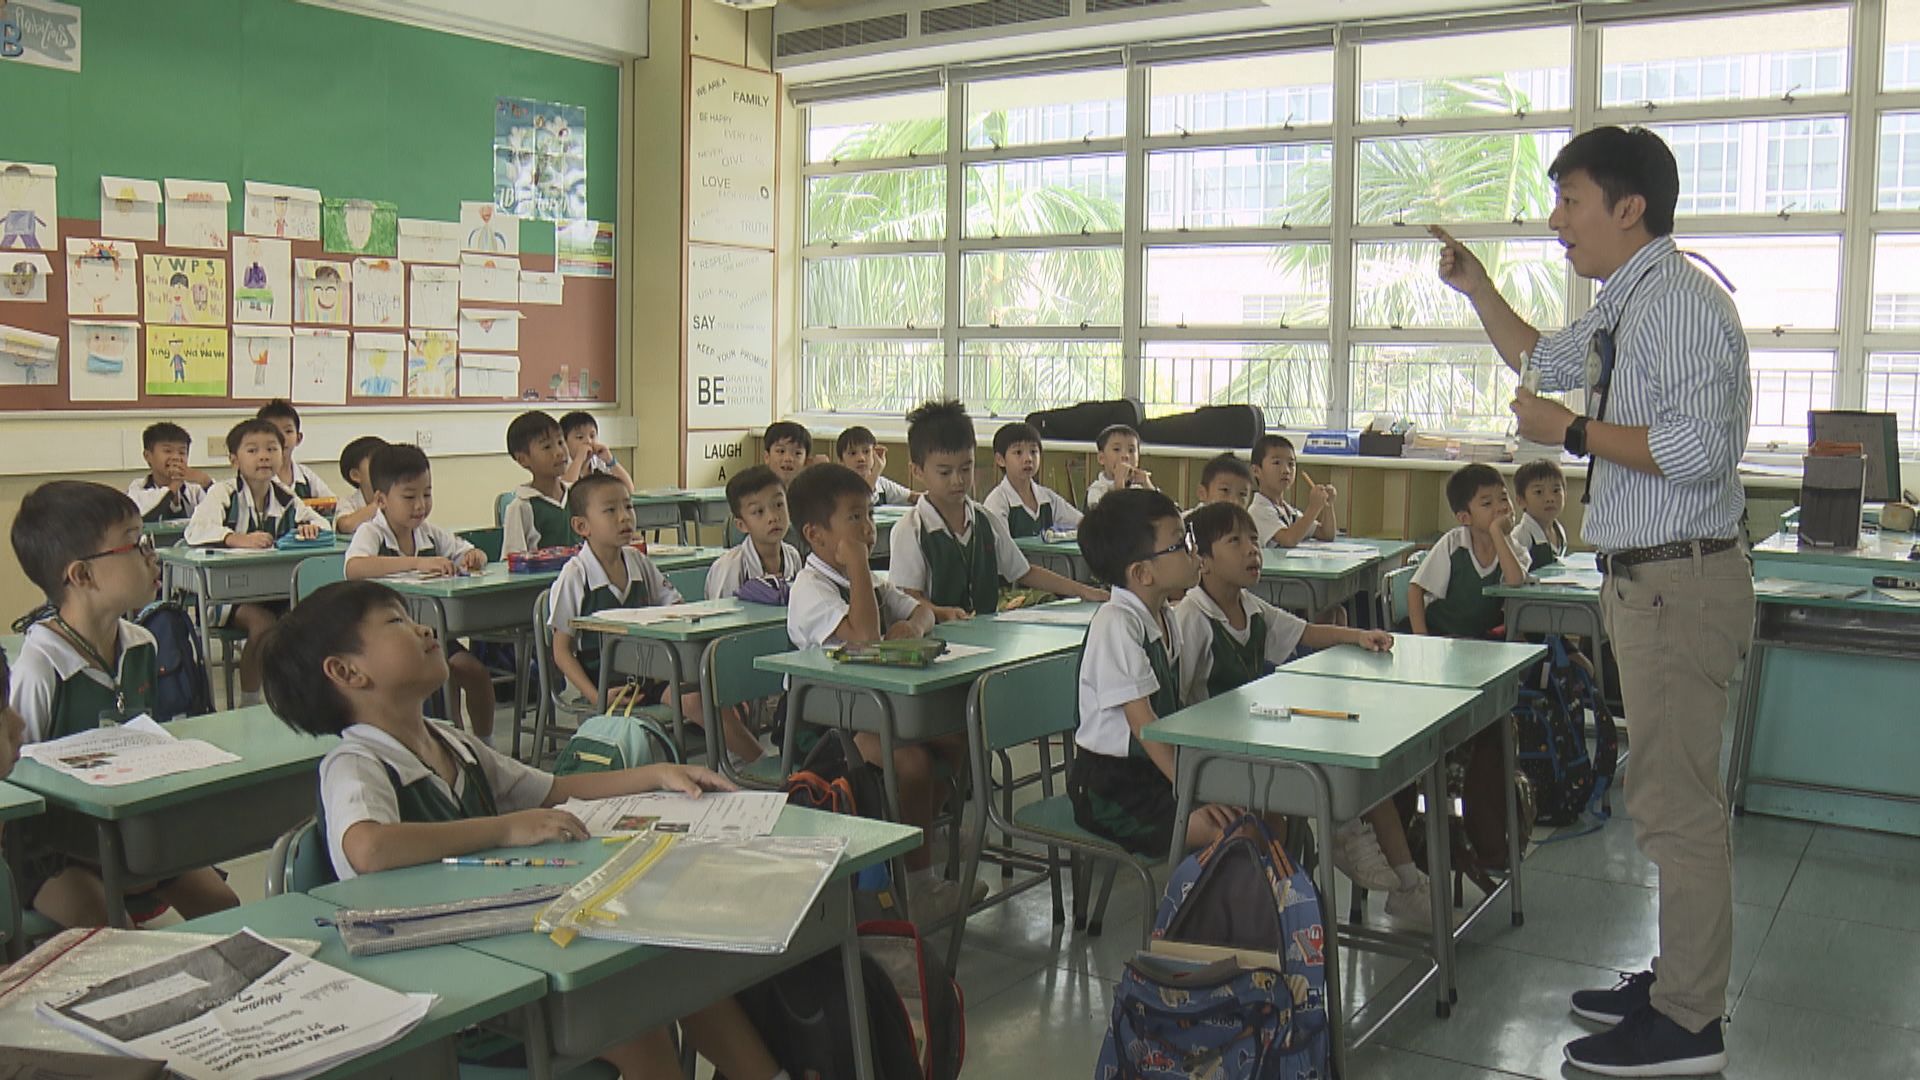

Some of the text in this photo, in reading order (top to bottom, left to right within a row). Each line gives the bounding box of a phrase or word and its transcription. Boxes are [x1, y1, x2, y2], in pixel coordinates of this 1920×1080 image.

[733, 91, 769, 107] FAMILY
[702, 175, 731, 189] LOVE
[693, 315, 716, 331] SAY
[697, 341, 768, 369] KEEP YOUR PROMISE
[698, 376, 725, 405] BE
[705, 443, 742, 459] LAUGH
[718, 466, 726, 481] A
